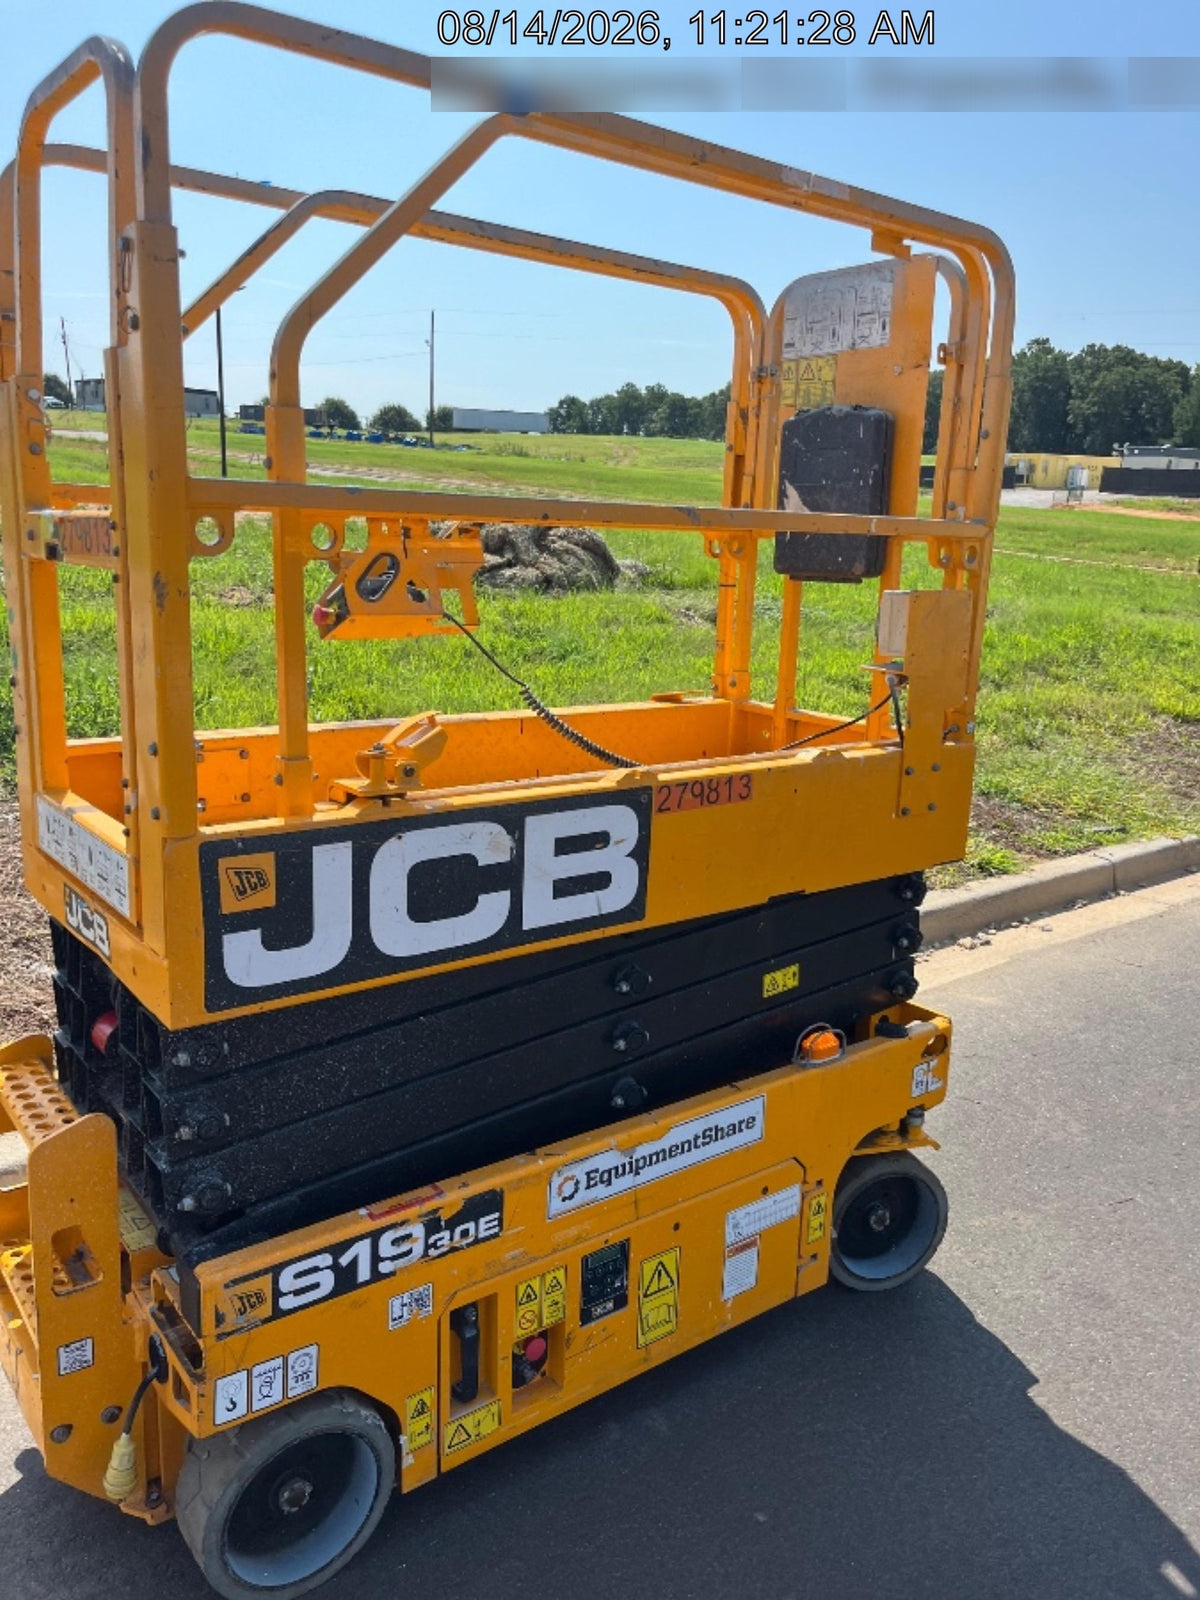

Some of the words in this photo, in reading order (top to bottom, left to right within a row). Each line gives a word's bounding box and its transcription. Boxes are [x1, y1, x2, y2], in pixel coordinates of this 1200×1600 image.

[656, 773, 752, 813] 279813
[222, 804, 640, 988] JCB
[234, 870, 267, 897] JCB
[65, 889, 111, 958] JCB
[584, 1115, 757, 1191] EquipmentShare
[237, 1291, 264, 1316] JCB
